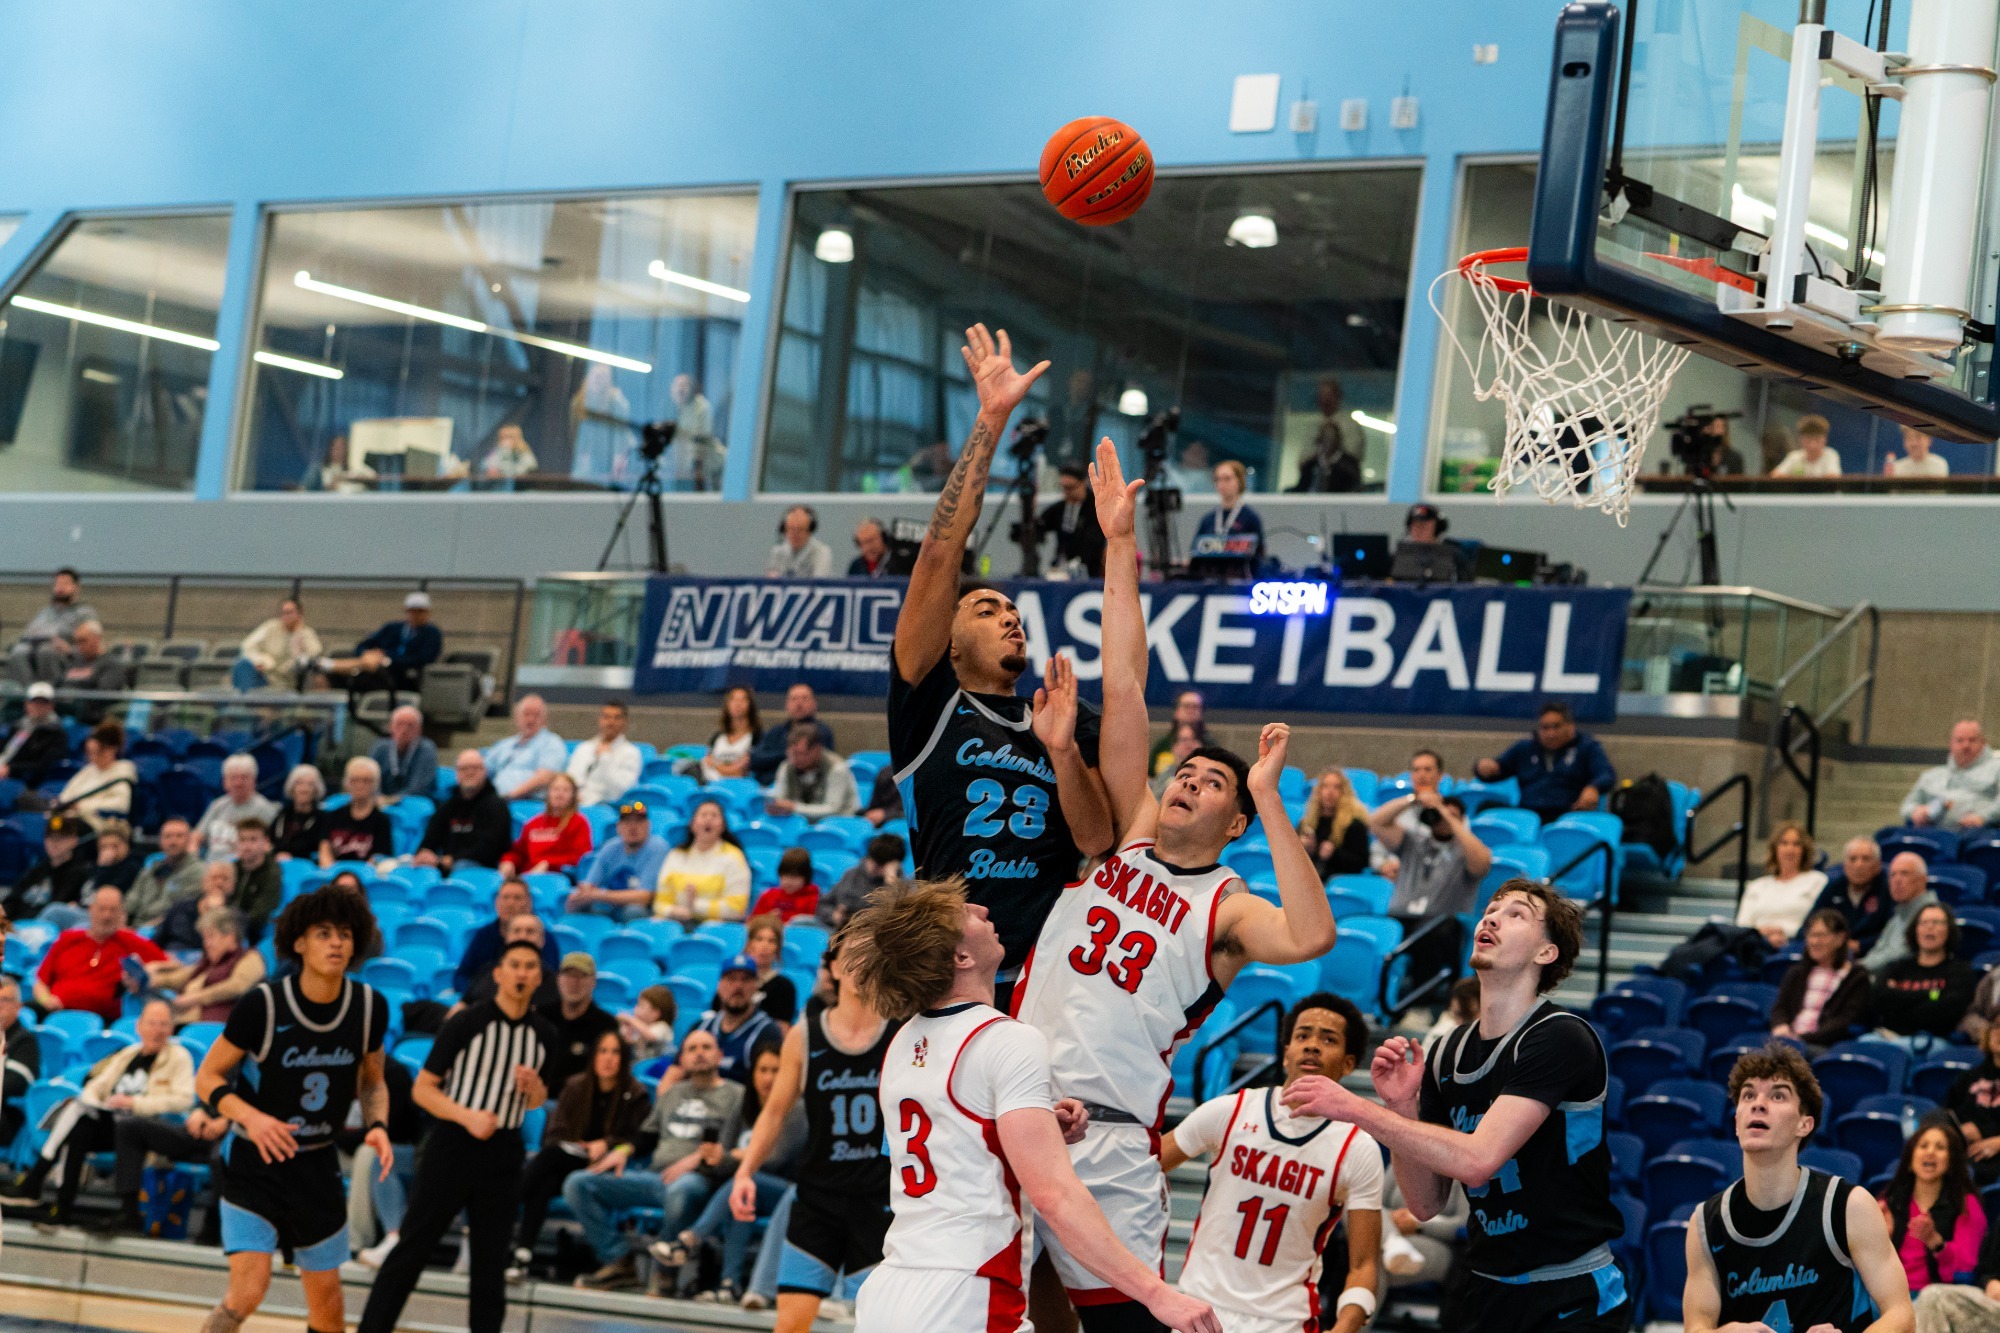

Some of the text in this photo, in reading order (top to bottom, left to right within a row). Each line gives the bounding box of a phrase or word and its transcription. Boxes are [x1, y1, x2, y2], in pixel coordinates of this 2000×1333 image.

[1065, 131, 1123, 181] Baden
[1250, 581, 1327, 615] STSPN
[656, 585, 1600, 694] NWAC ASKETBALL
[962, 778, 1050, 840] 23
[964, 848, 1039, 879] Basin
[1094, 855, 1191, 935] SKAGIT
[1068, 905, 1157, 995] 33
[300, 1071, 330, 1112] 3
[830, 1092, 877, 1136] 10
[899, 1098, 938, 1198] 3
[1231, 1144, 1325, 1200] SKAGIT
[1234, 1195, 1291, 1267] 11
[1727, 1262, 1819, 1298] Columbia
